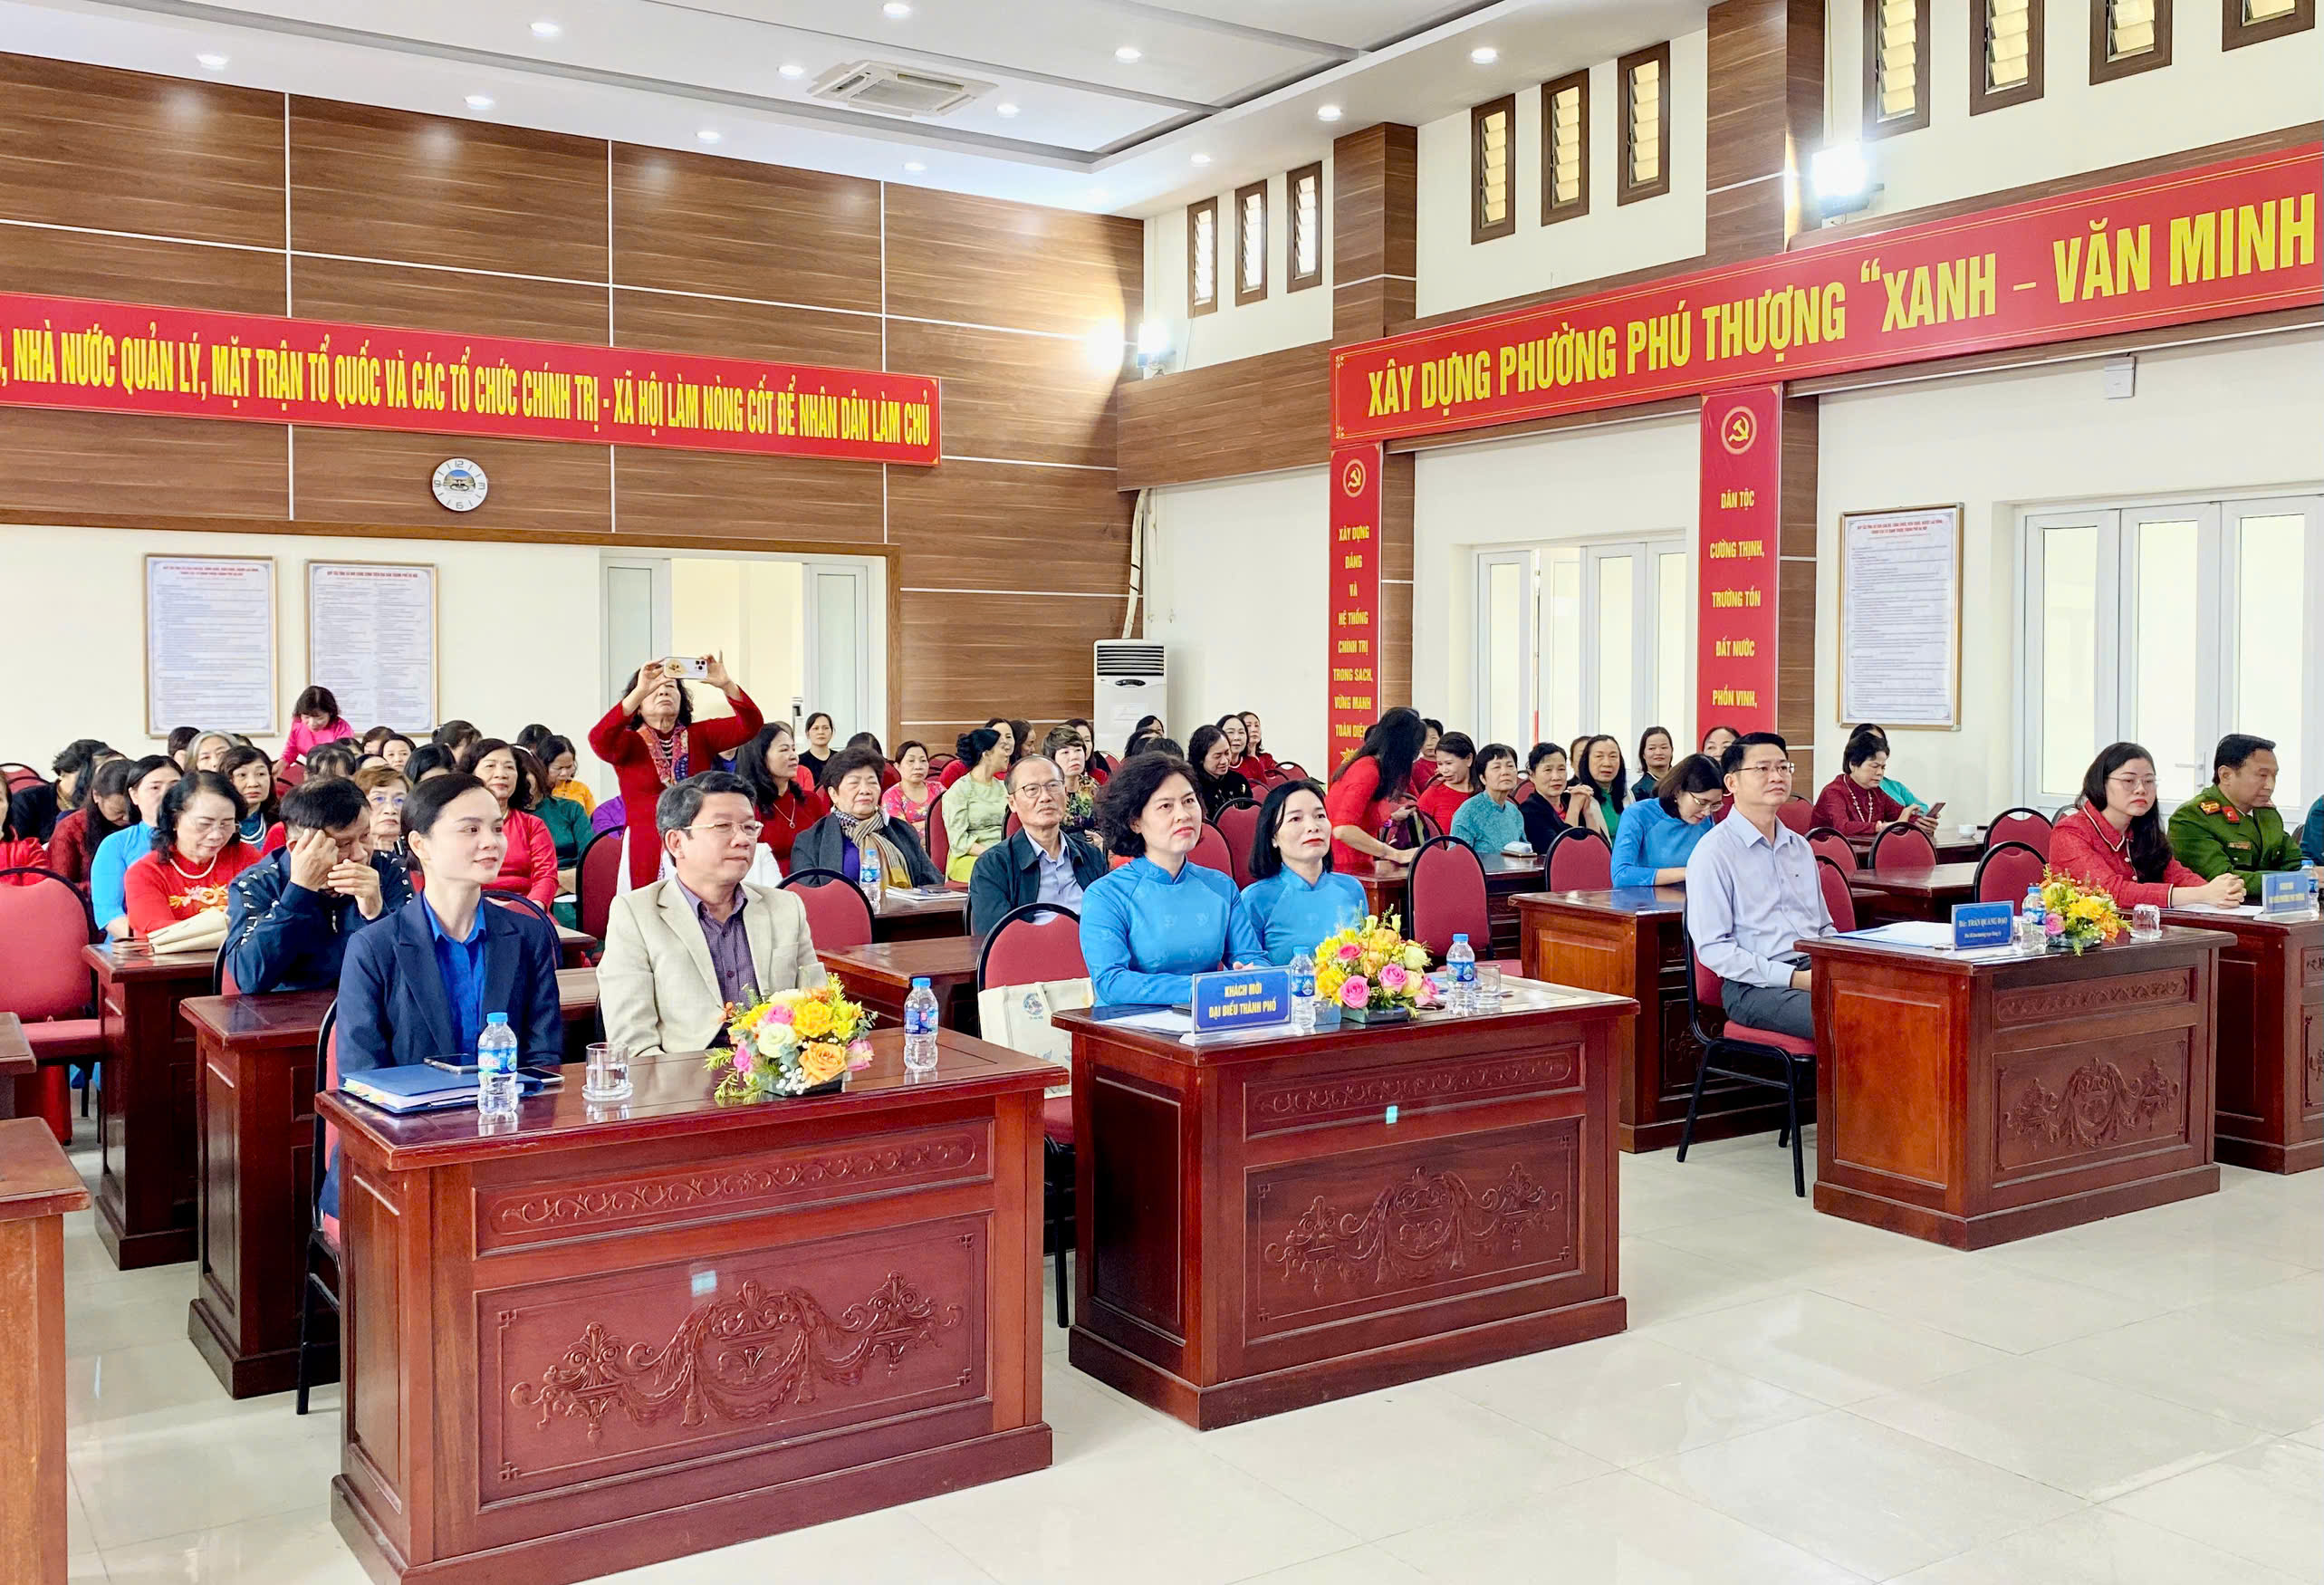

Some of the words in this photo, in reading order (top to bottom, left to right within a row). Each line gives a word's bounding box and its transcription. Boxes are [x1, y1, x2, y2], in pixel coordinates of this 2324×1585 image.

[1368, 359, 1413, 417] XÂY
[1422, 351, 1491, 416] DỰNG
[1500, 322, 1617, 395] PHƯỜNG
[1628, 300, 1690, 374] PHÚ
[1702, 282, 1846, 362] THƯỢNG
[1860, 253, 1996, 332] “XANH
[2053, 217, 2150, 303] VĂN
[2170, 193, 2316, 287] MINH
[14, 320, 56, 382] NHÀ
[62, 323, 115, 387] NƯỚC
[121, 322, 173, 394] QUẢN
[179, 332, 206, 400] LÝ,
[212, 336, 251, 408] MẶT
[256, 340, 303, 410] TRẬN
[308, 334, 330, 402] TỔ
[335, 340, 380, 409] QUỐC
[385, 350, 408, 408] VÀ
[412, 352, 445, 410] CÁC
[449, 346, 470, 412] TỔ
[475, 359, 517, 416] CHỨC
[523, 362, 570, 419] CHÍNH
[574, 375, 599, 432] TRỊ
[614, 370, 634, 424] XÃ
[639, 371, 663, 436] HỘI
[667, 374, 698, 428] LÀM
[703, 376, 743, 432] NÒNG
[747, 375, 773, 434] CỐT
[777, 375, 795, 435] ĐỂ
[800, 386, 837, 438] NHÂN
[841, 389, 869, 440] DÂN
[872, 391, 900, 443] LÀM
[904, 389, 930, 446] CHỦ
[455, 460, 464, 468] 12
[434, 479, 441, 487] 9
[478, 482, 485, 490] 3
[1224, 983, 1247, 997] KHÁCH
